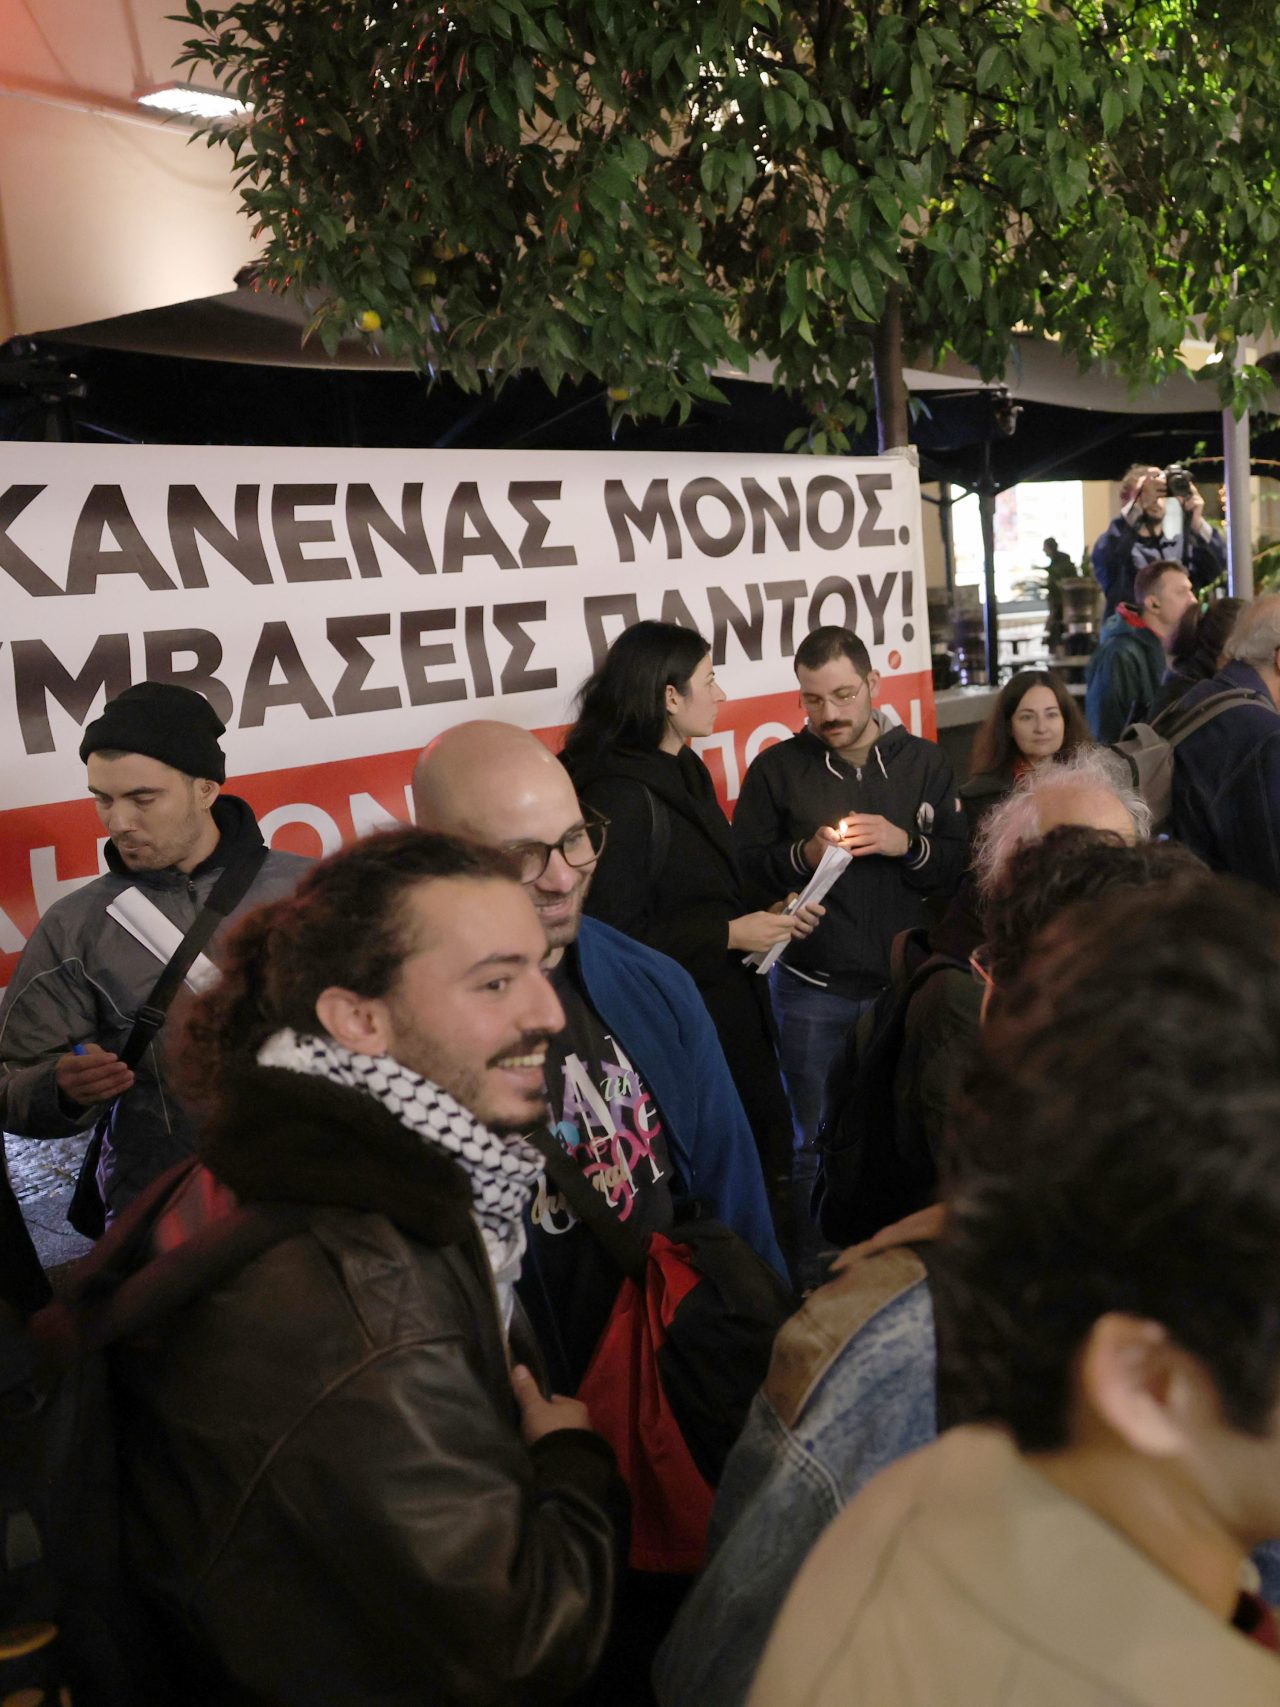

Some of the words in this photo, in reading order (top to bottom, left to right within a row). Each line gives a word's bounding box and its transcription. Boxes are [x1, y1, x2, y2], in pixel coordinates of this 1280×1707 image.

[0, 480, 578, 597] ΚΑΝΕΝΑΣ
[604, 473, 910, 562] ΜΟΝΟΣ.
[0, 600, 558, 755] ΜΒΑΣΕΙΣ
